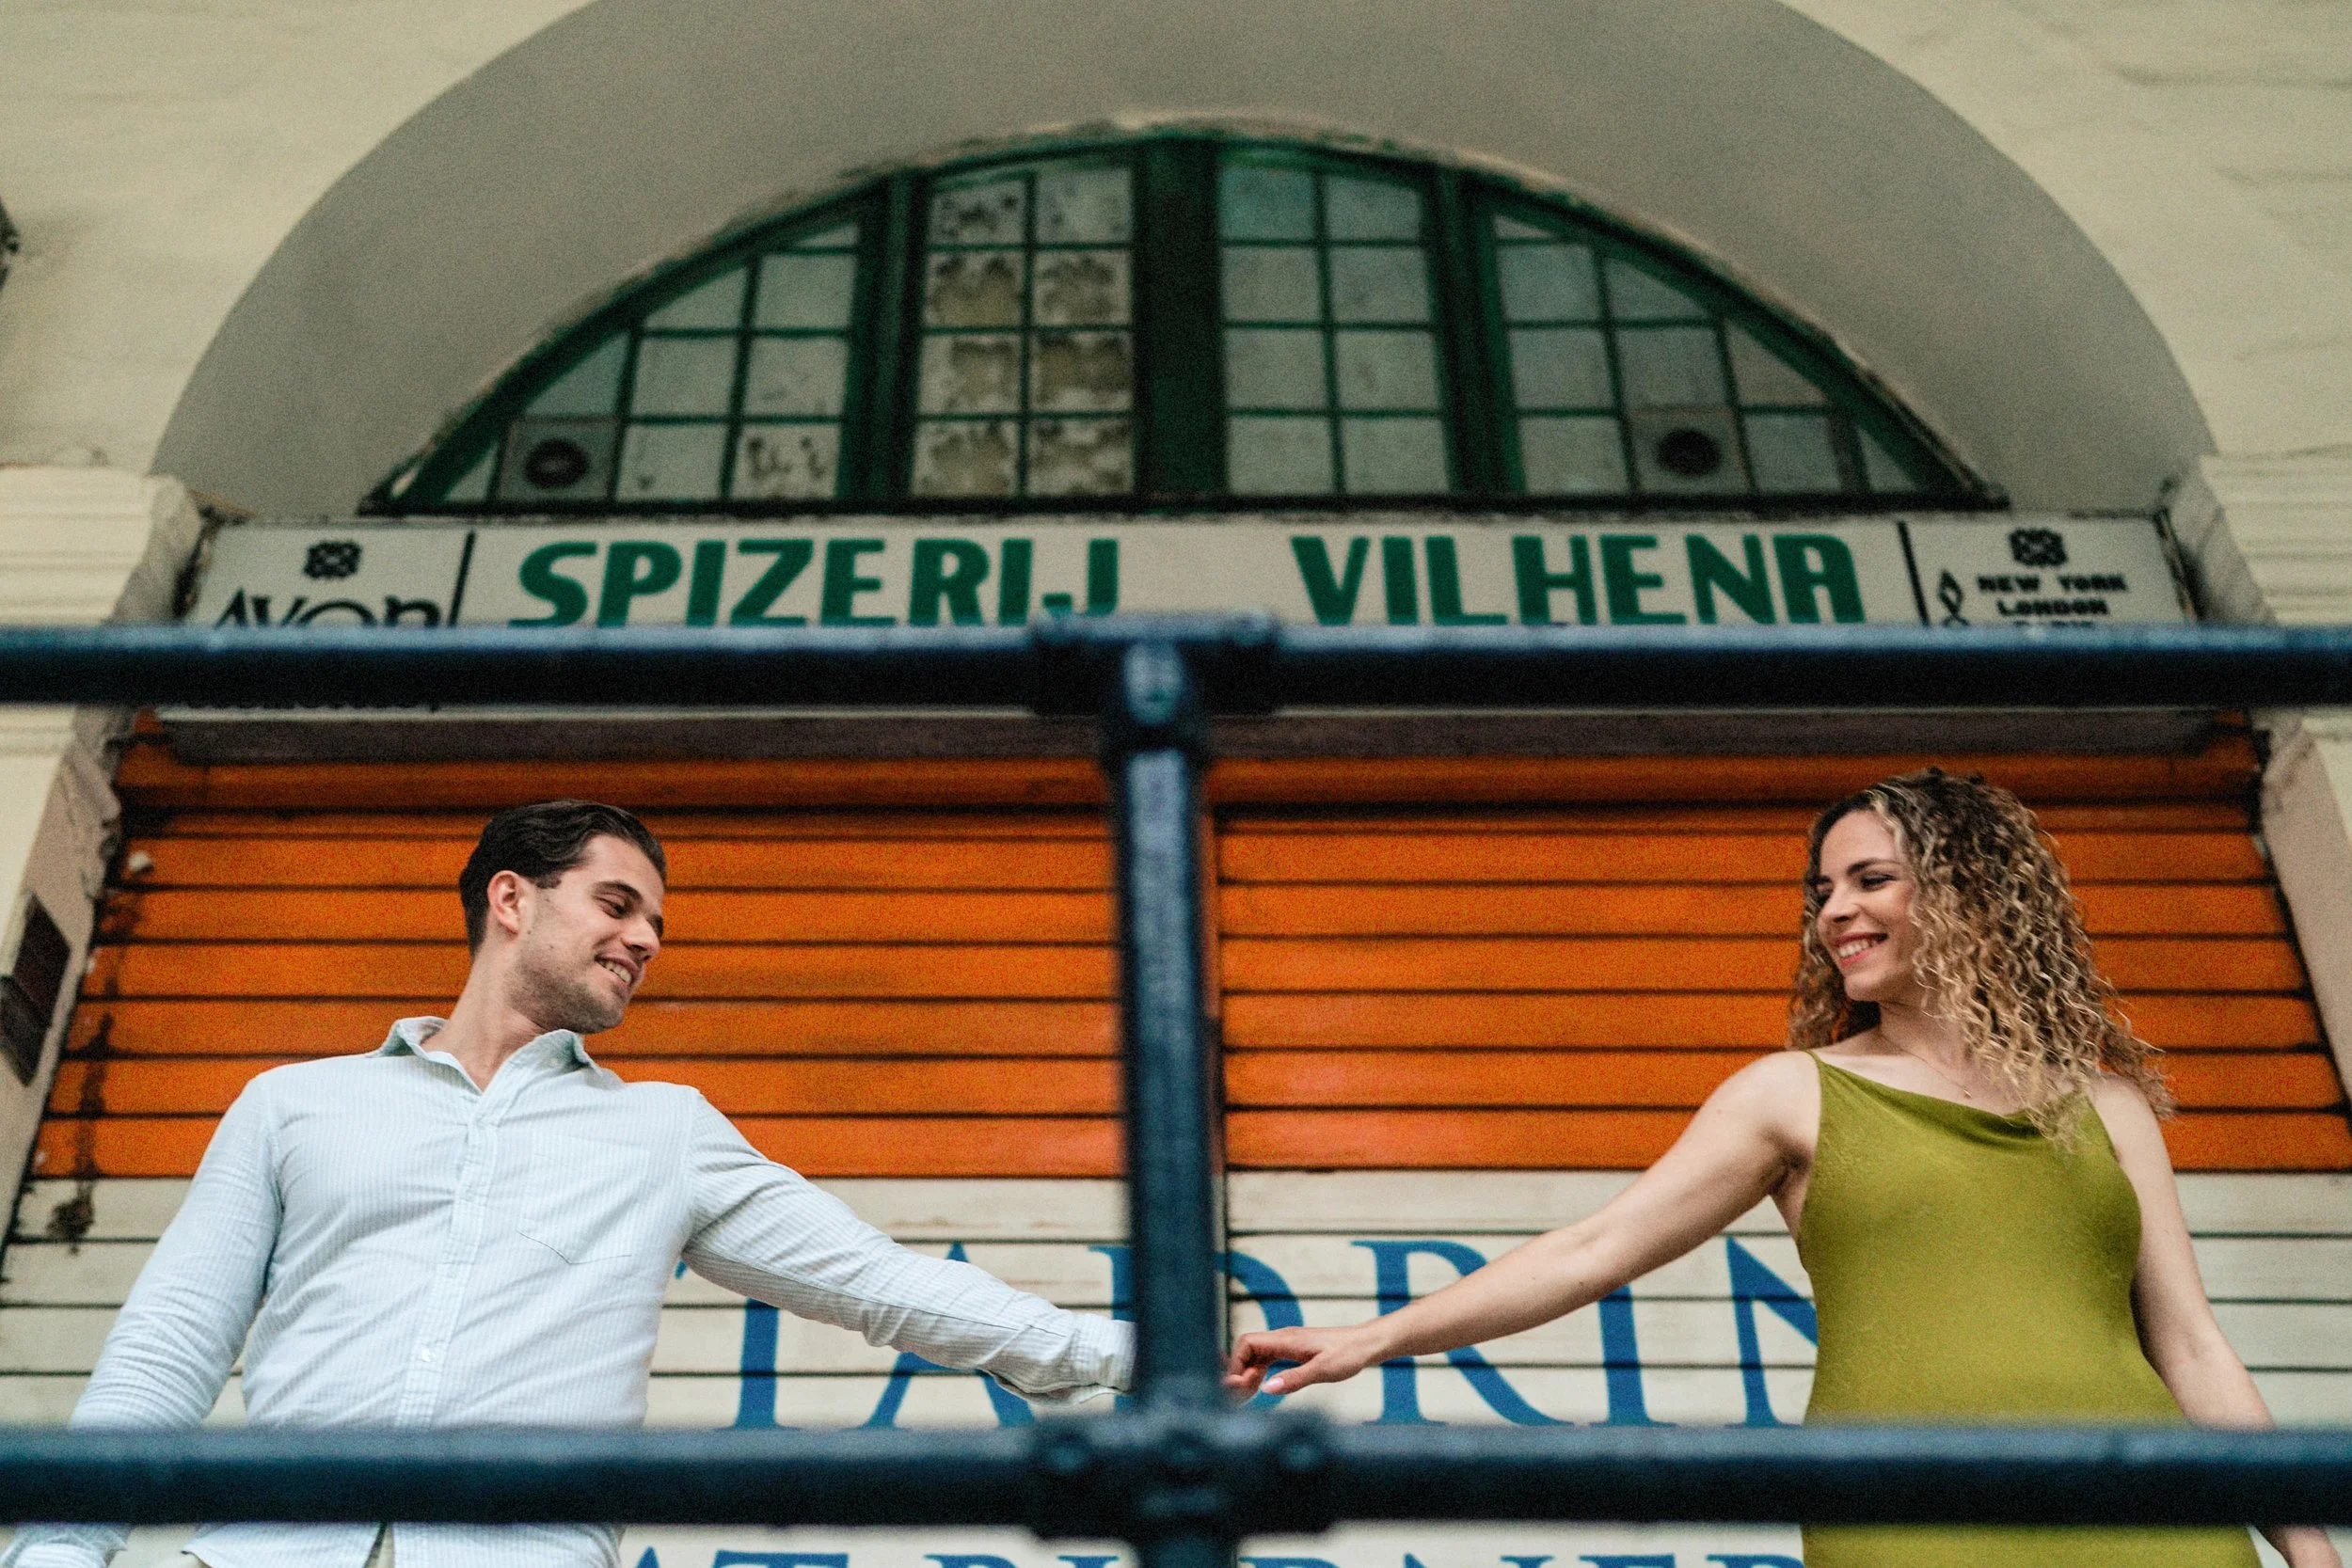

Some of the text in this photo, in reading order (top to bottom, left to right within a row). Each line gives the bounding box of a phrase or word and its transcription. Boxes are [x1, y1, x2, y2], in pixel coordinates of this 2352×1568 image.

[507, 533, 1867, 627] SPIZERIJ VILHENA
[1978, 574, 2128, 592] NEW YORK
[1996, 598, 2109, 616] LONDON
